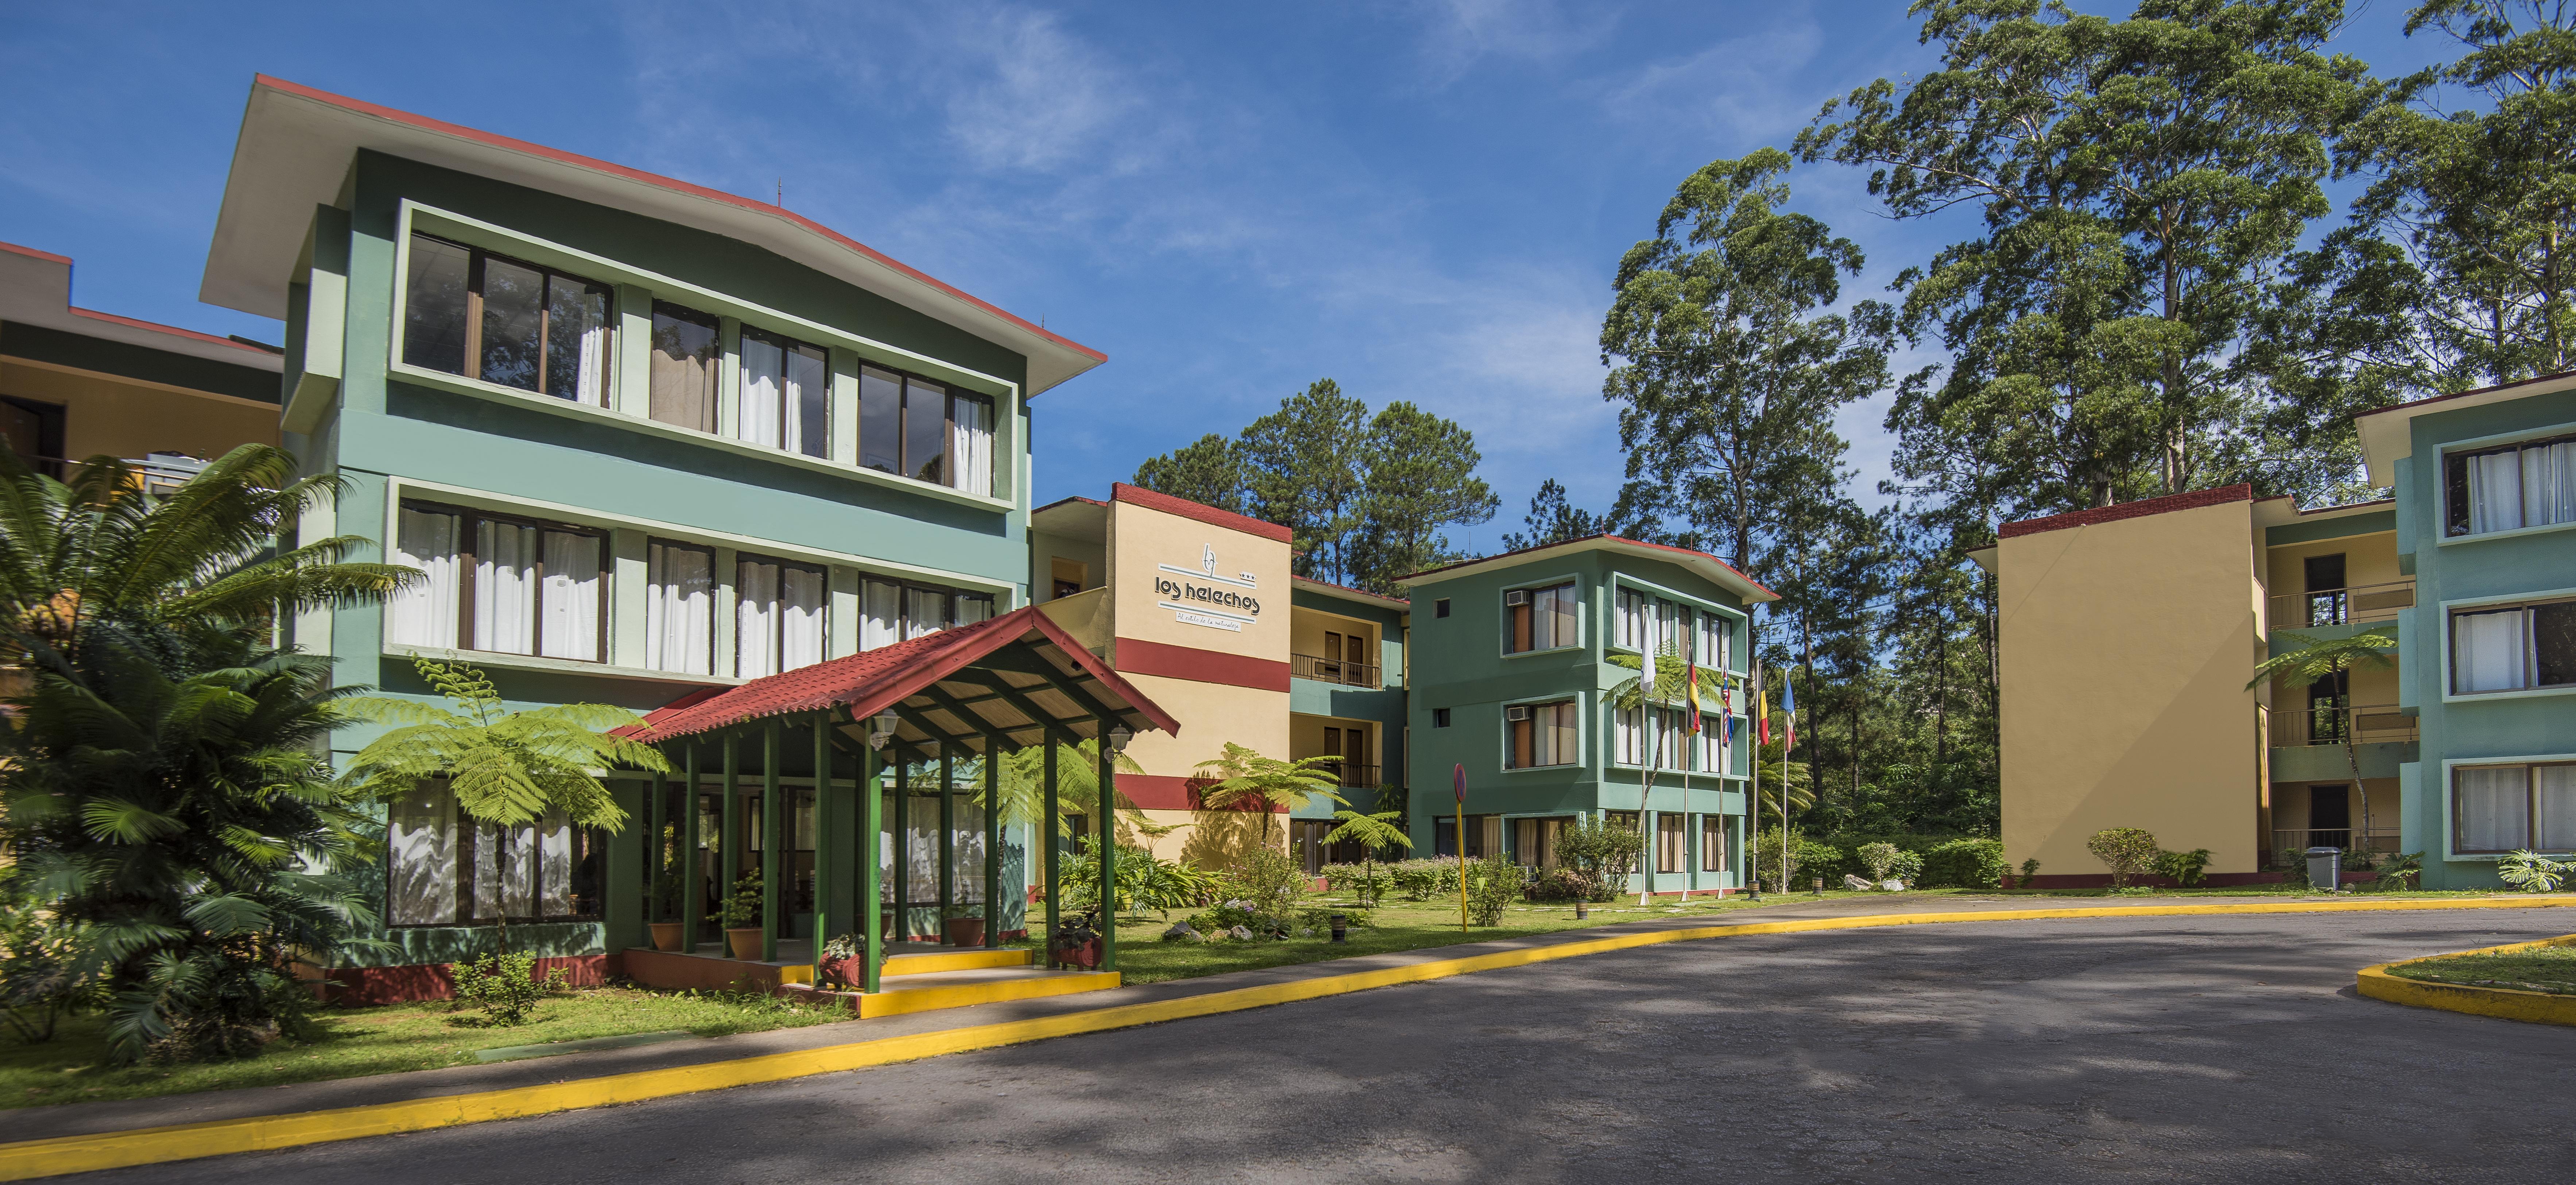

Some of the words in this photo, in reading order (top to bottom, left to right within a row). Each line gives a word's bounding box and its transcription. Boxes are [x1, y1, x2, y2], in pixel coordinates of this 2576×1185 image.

[1155, 576, 1181, 599] los
[1186, 582, 1260, 614] helechos
[1215, 621, 1239, 630] naturaleza
